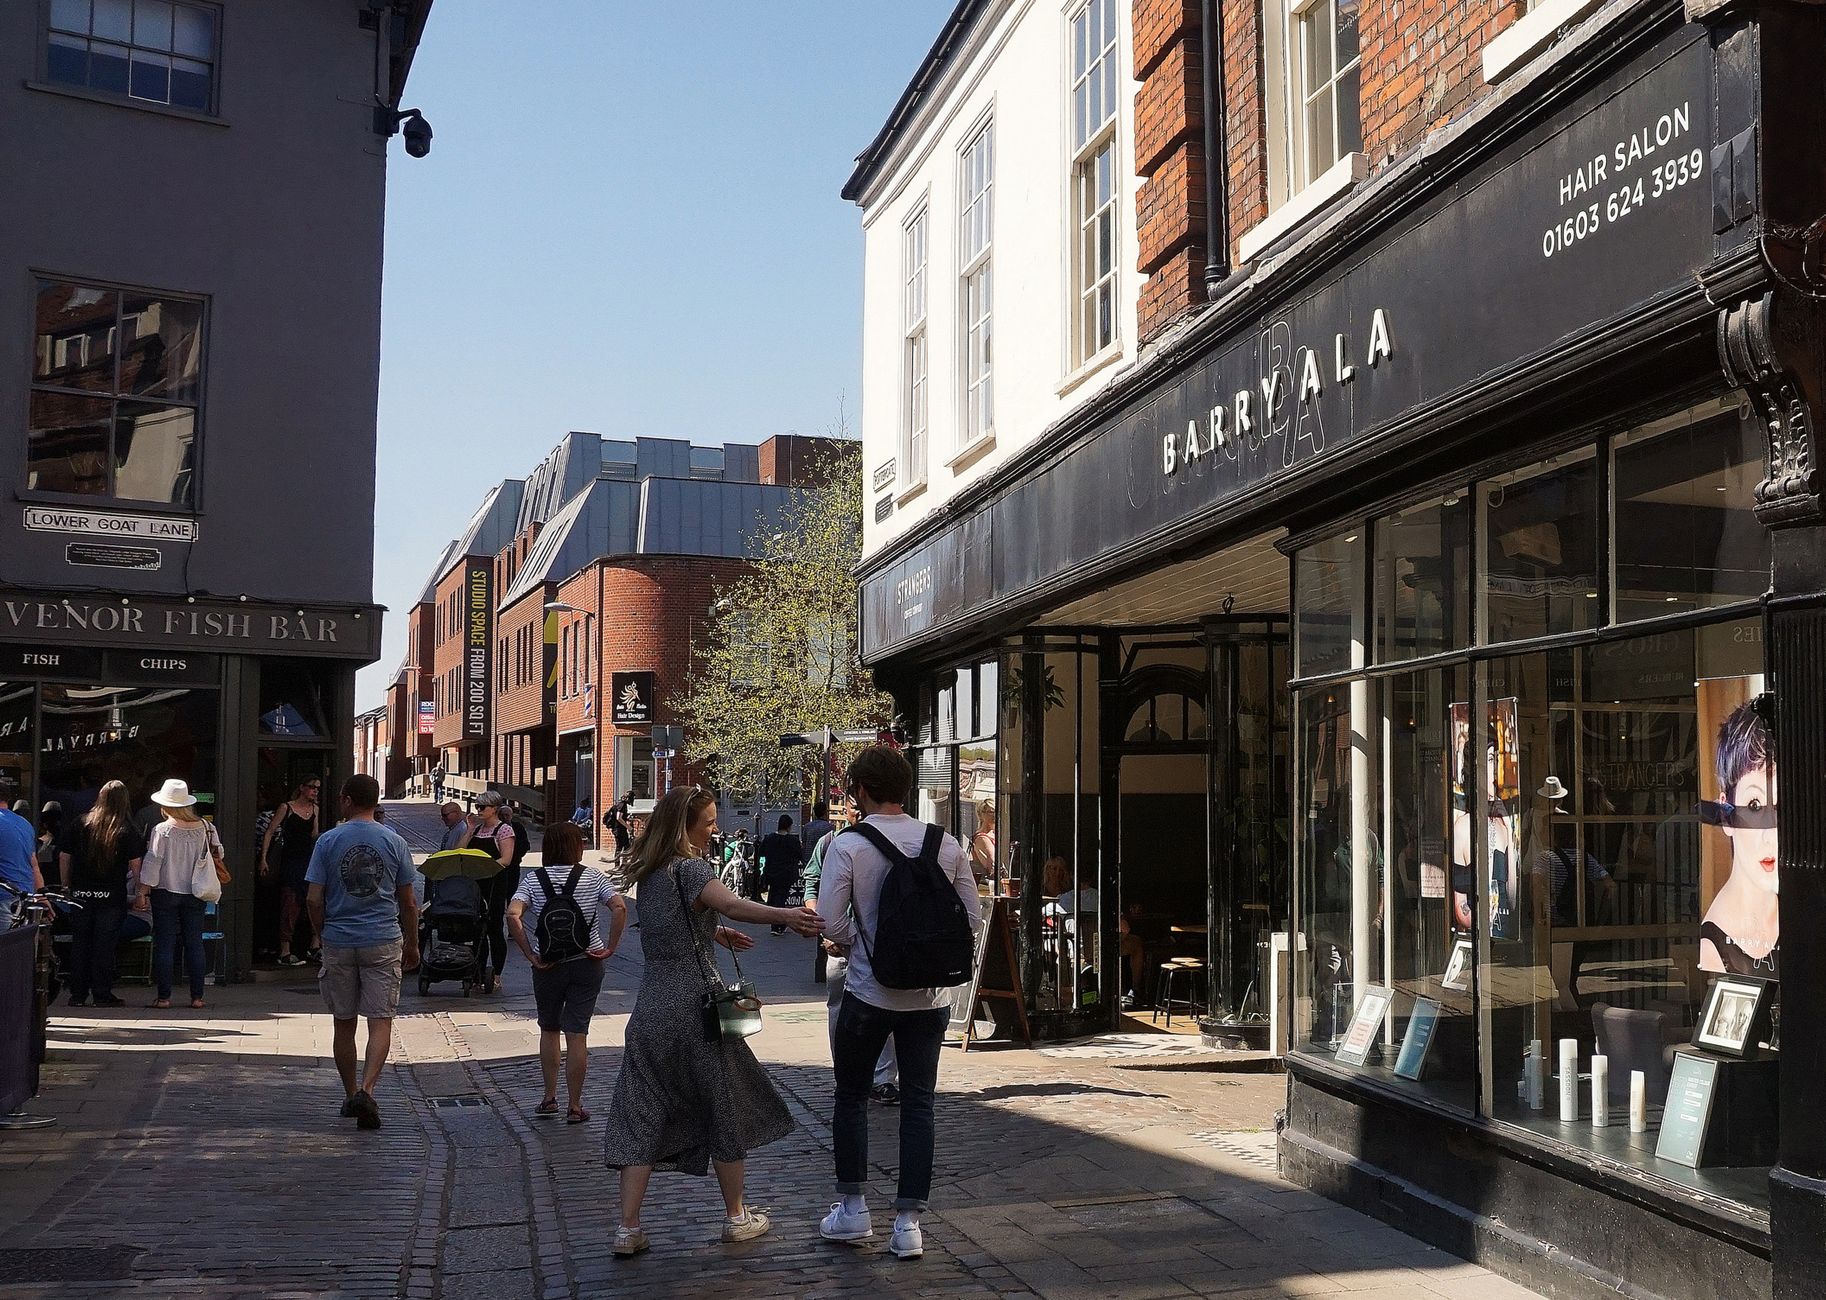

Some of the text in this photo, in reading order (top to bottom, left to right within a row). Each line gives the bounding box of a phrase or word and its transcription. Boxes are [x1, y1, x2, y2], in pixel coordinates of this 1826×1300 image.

[1558, 101, 1690, 206] HAIR SALON
[1542, 148, 1704, 258] 01603 624 3939
[32, 513, 190, 537] LOWER GOAT LANE
[5, 600, 338, 642] VENOR FISH BAR
[22, 653, 60, 666] FISH
[140, 658, 187, 670] CHIPS
[469, 570, 487, 735] STUDIO SPACE FROM 200 SQ FT
[93, 891, 110, 899] YOU
